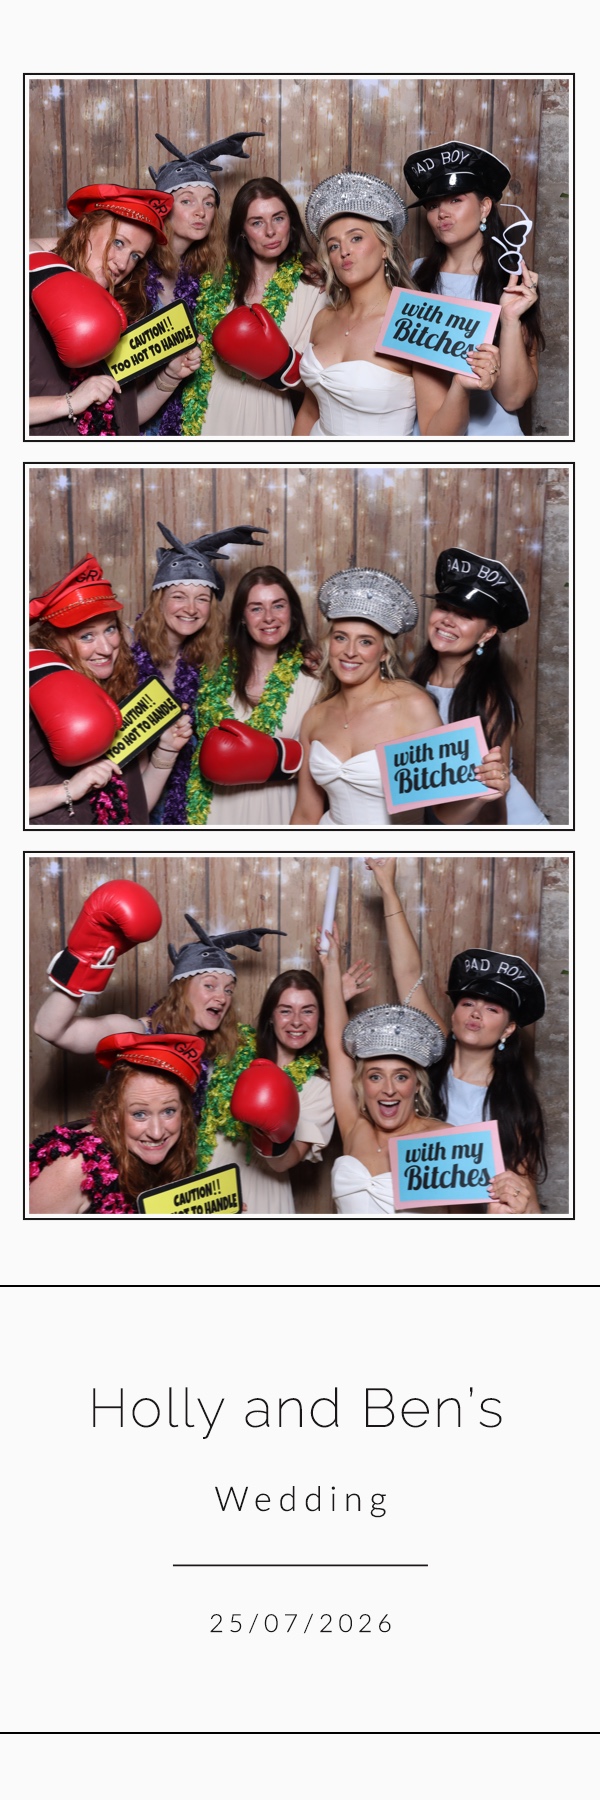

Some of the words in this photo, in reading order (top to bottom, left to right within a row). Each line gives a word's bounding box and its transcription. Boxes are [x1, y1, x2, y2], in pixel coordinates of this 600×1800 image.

[441, 149, 470, 165] BOY
[129, 316, 174, 350] CAUTION!!
[401, 302, 443, 325] with
[445, 314, 481, 339] my
[111, 359, 131, 375] TOO
[130, 349, 149, 366] HOT
[149, 343, 162, 356] TO
[160, 325, 194, 351] HANDLE
[477, 565, 506, 587] BOY
[119, 693, 156, 732] AUTION!!
[107, 741, 126, 758] TOO
[122, 728, 142, 746] HOT
[137, 720, 152, 733] TO
[146, 697, 178, 726] HANDLE
[394, 743, 434, 767] with
[438, 739, 469, 761] my
[394, 762, 478, 794] Bitches
[464, 957, 491, 973] BAD
[496, 961, 527, 982] BOY
[405, 1141, 447, 1164] with
[451, 1142, 485, 1165] my
[404, 1163, 493, 1191] Bitches
[173, 1178, 222, 1207] CAUTION!!
[190, 1204, 204, 1214] TO
[204, 1193, 238, 1214] HANDLE
